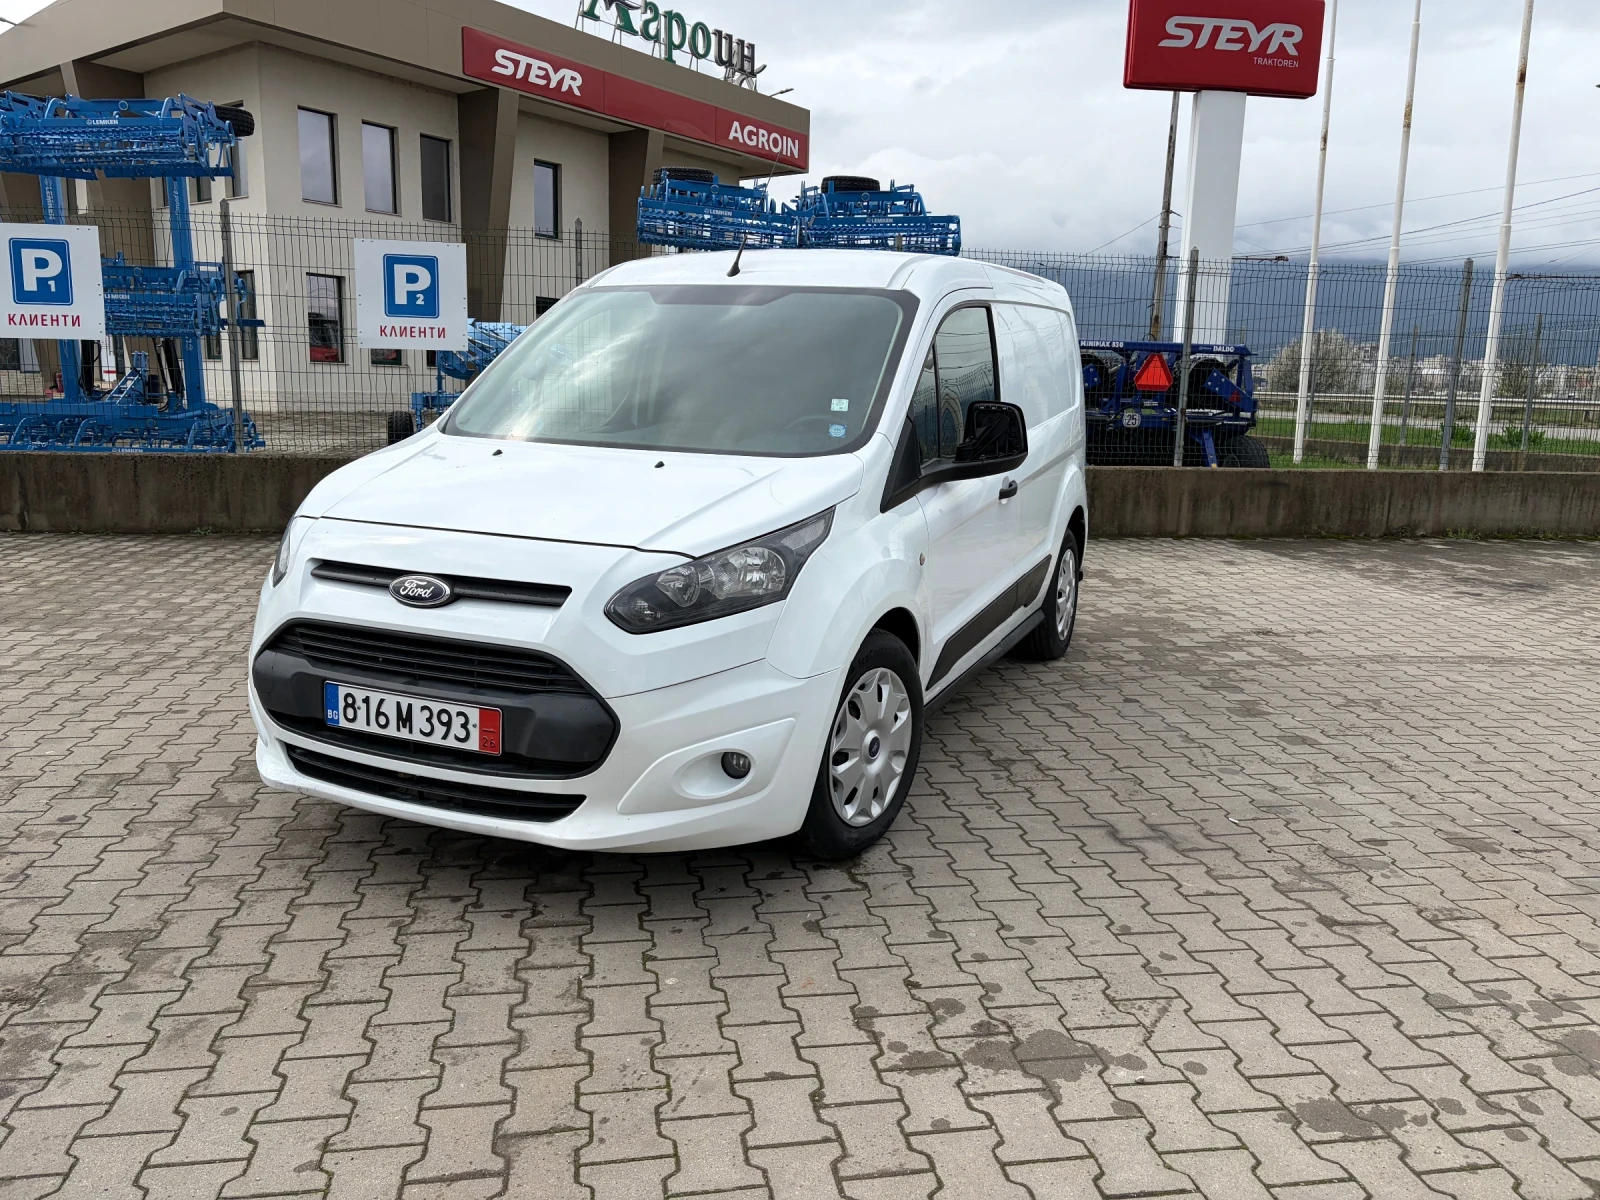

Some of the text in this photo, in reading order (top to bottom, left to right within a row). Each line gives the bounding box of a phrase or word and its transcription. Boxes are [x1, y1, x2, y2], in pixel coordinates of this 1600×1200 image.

[1157, 15, 1304, 56] STEYR
[1253, 56, 1299, 68] TRAKTOREN
[491, 48, 583, 97] STEYR
[728, 120, 799, 158] AGROIN
[8, 313, 81, 328] КЛИЕНТИ
[379, 325, 446, 339] КЛИЕНТИ
[1126, 413, 1138, 426] 25
[399, 579, 435, 598] Ford
[327, 709, 339, 720] BG
[482, 735, 496, 749] 26
